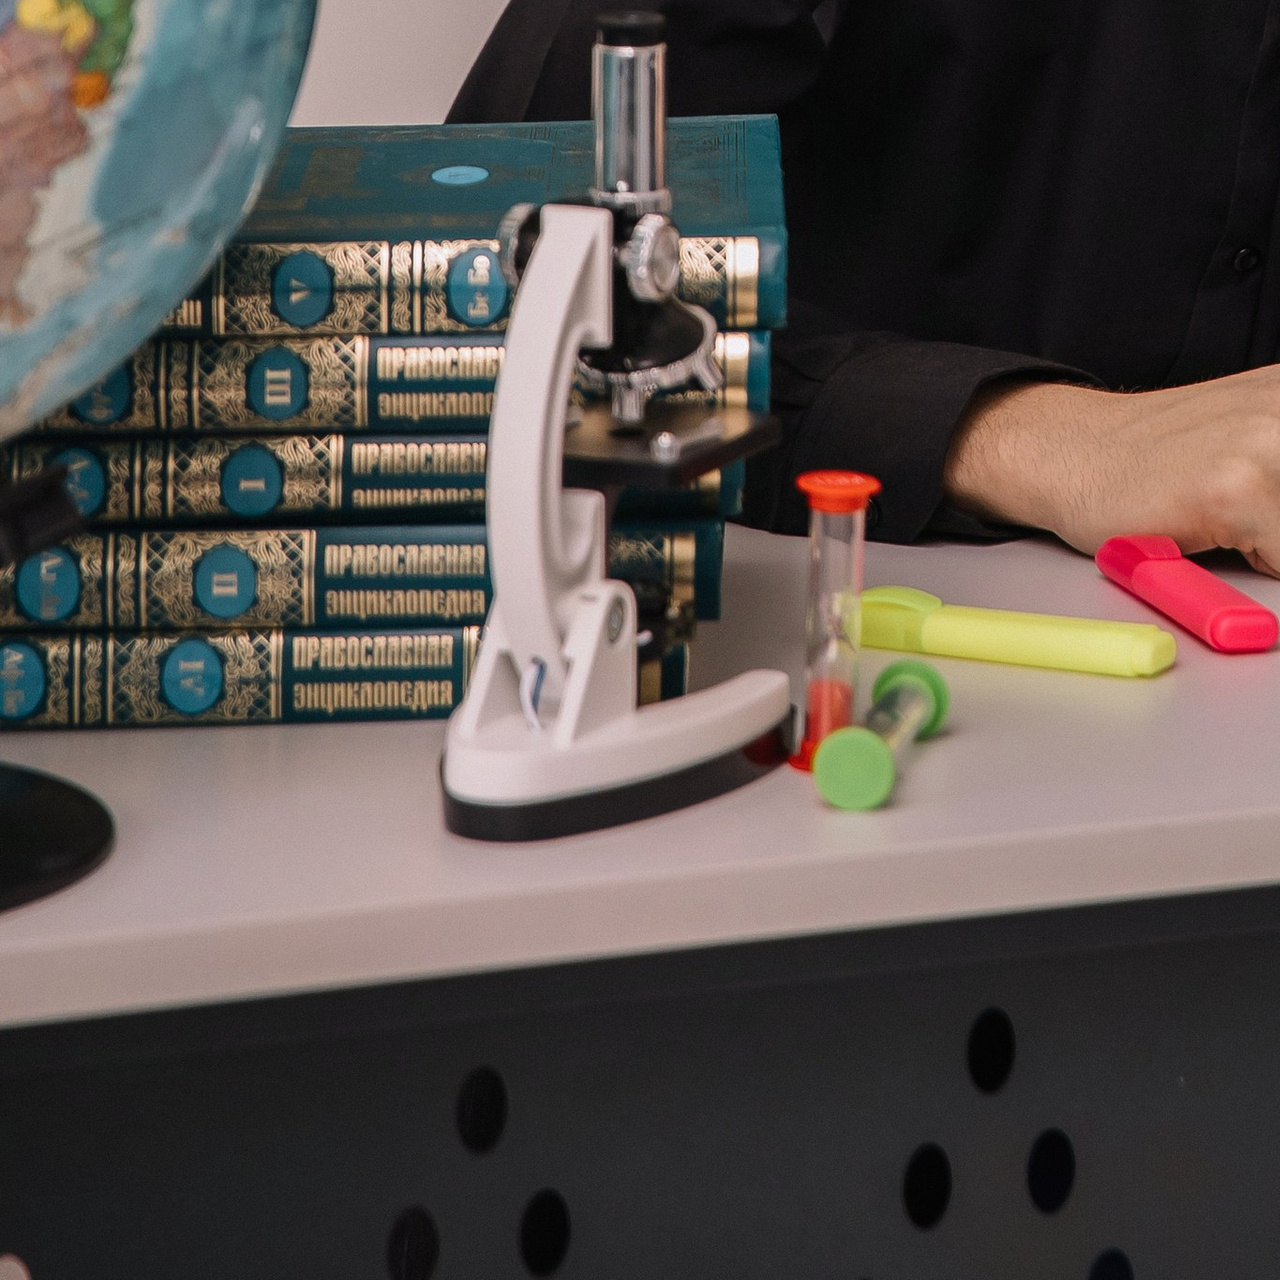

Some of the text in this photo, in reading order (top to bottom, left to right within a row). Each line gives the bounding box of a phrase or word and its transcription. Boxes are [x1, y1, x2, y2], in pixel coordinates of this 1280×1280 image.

[377, 347, 506, 381] ПРАВОСЛАВ
[351, 442, 486, 474] ПРАВОСЛАВН
[324, 543, 486, 577] ПРАВОСЛАВНАЯ
[325, 589, 486, 621] ЭНЦИКЛОПЕДИЯ
[292, 634, 454, 669] ПРАВОСЛАВНАЯ
[292, 679, 454, 714] ЭНЦИКЛОПЕДИЯ
